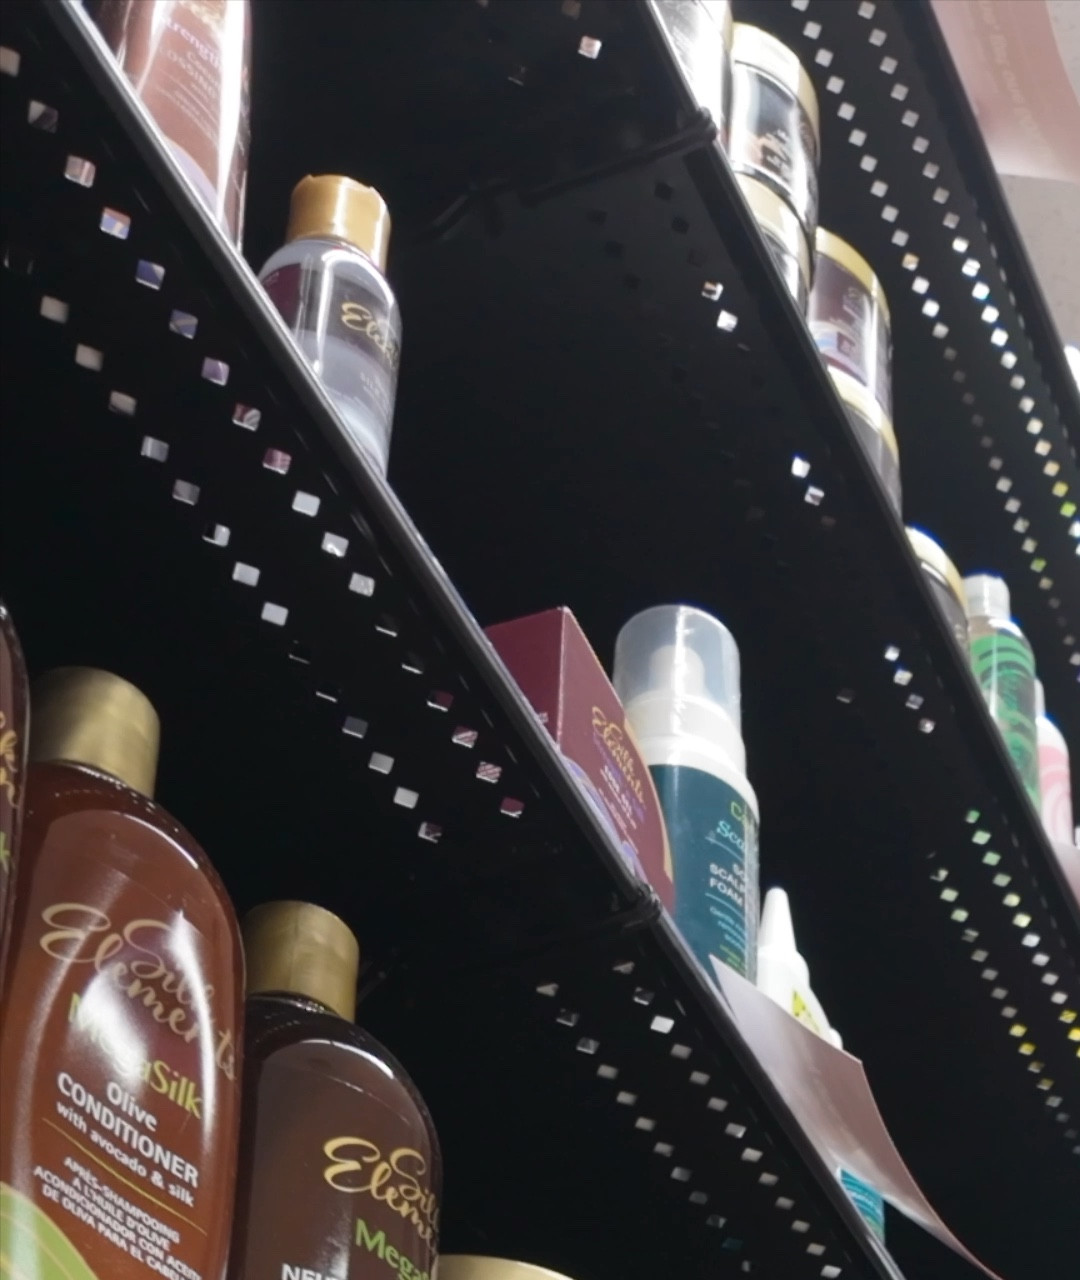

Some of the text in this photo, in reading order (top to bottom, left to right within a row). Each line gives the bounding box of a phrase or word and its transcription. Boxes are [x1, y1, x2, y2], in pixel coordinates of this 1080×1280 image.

[57, 1072, 199, 1188] CONDITIONER
[107, 1081, 158, 1132] Olive
[56, 1101, 194, 1208] with avocado & silk
[33, 1165, 136, 1243] ACONDICIONADOR
[138, 1236, 164, 1260] CON
[42, 1183, 60, 1203] DE
[62, 1196, 96, 1230] OLIVA
[97, 1221, 128, 1252] PARA
